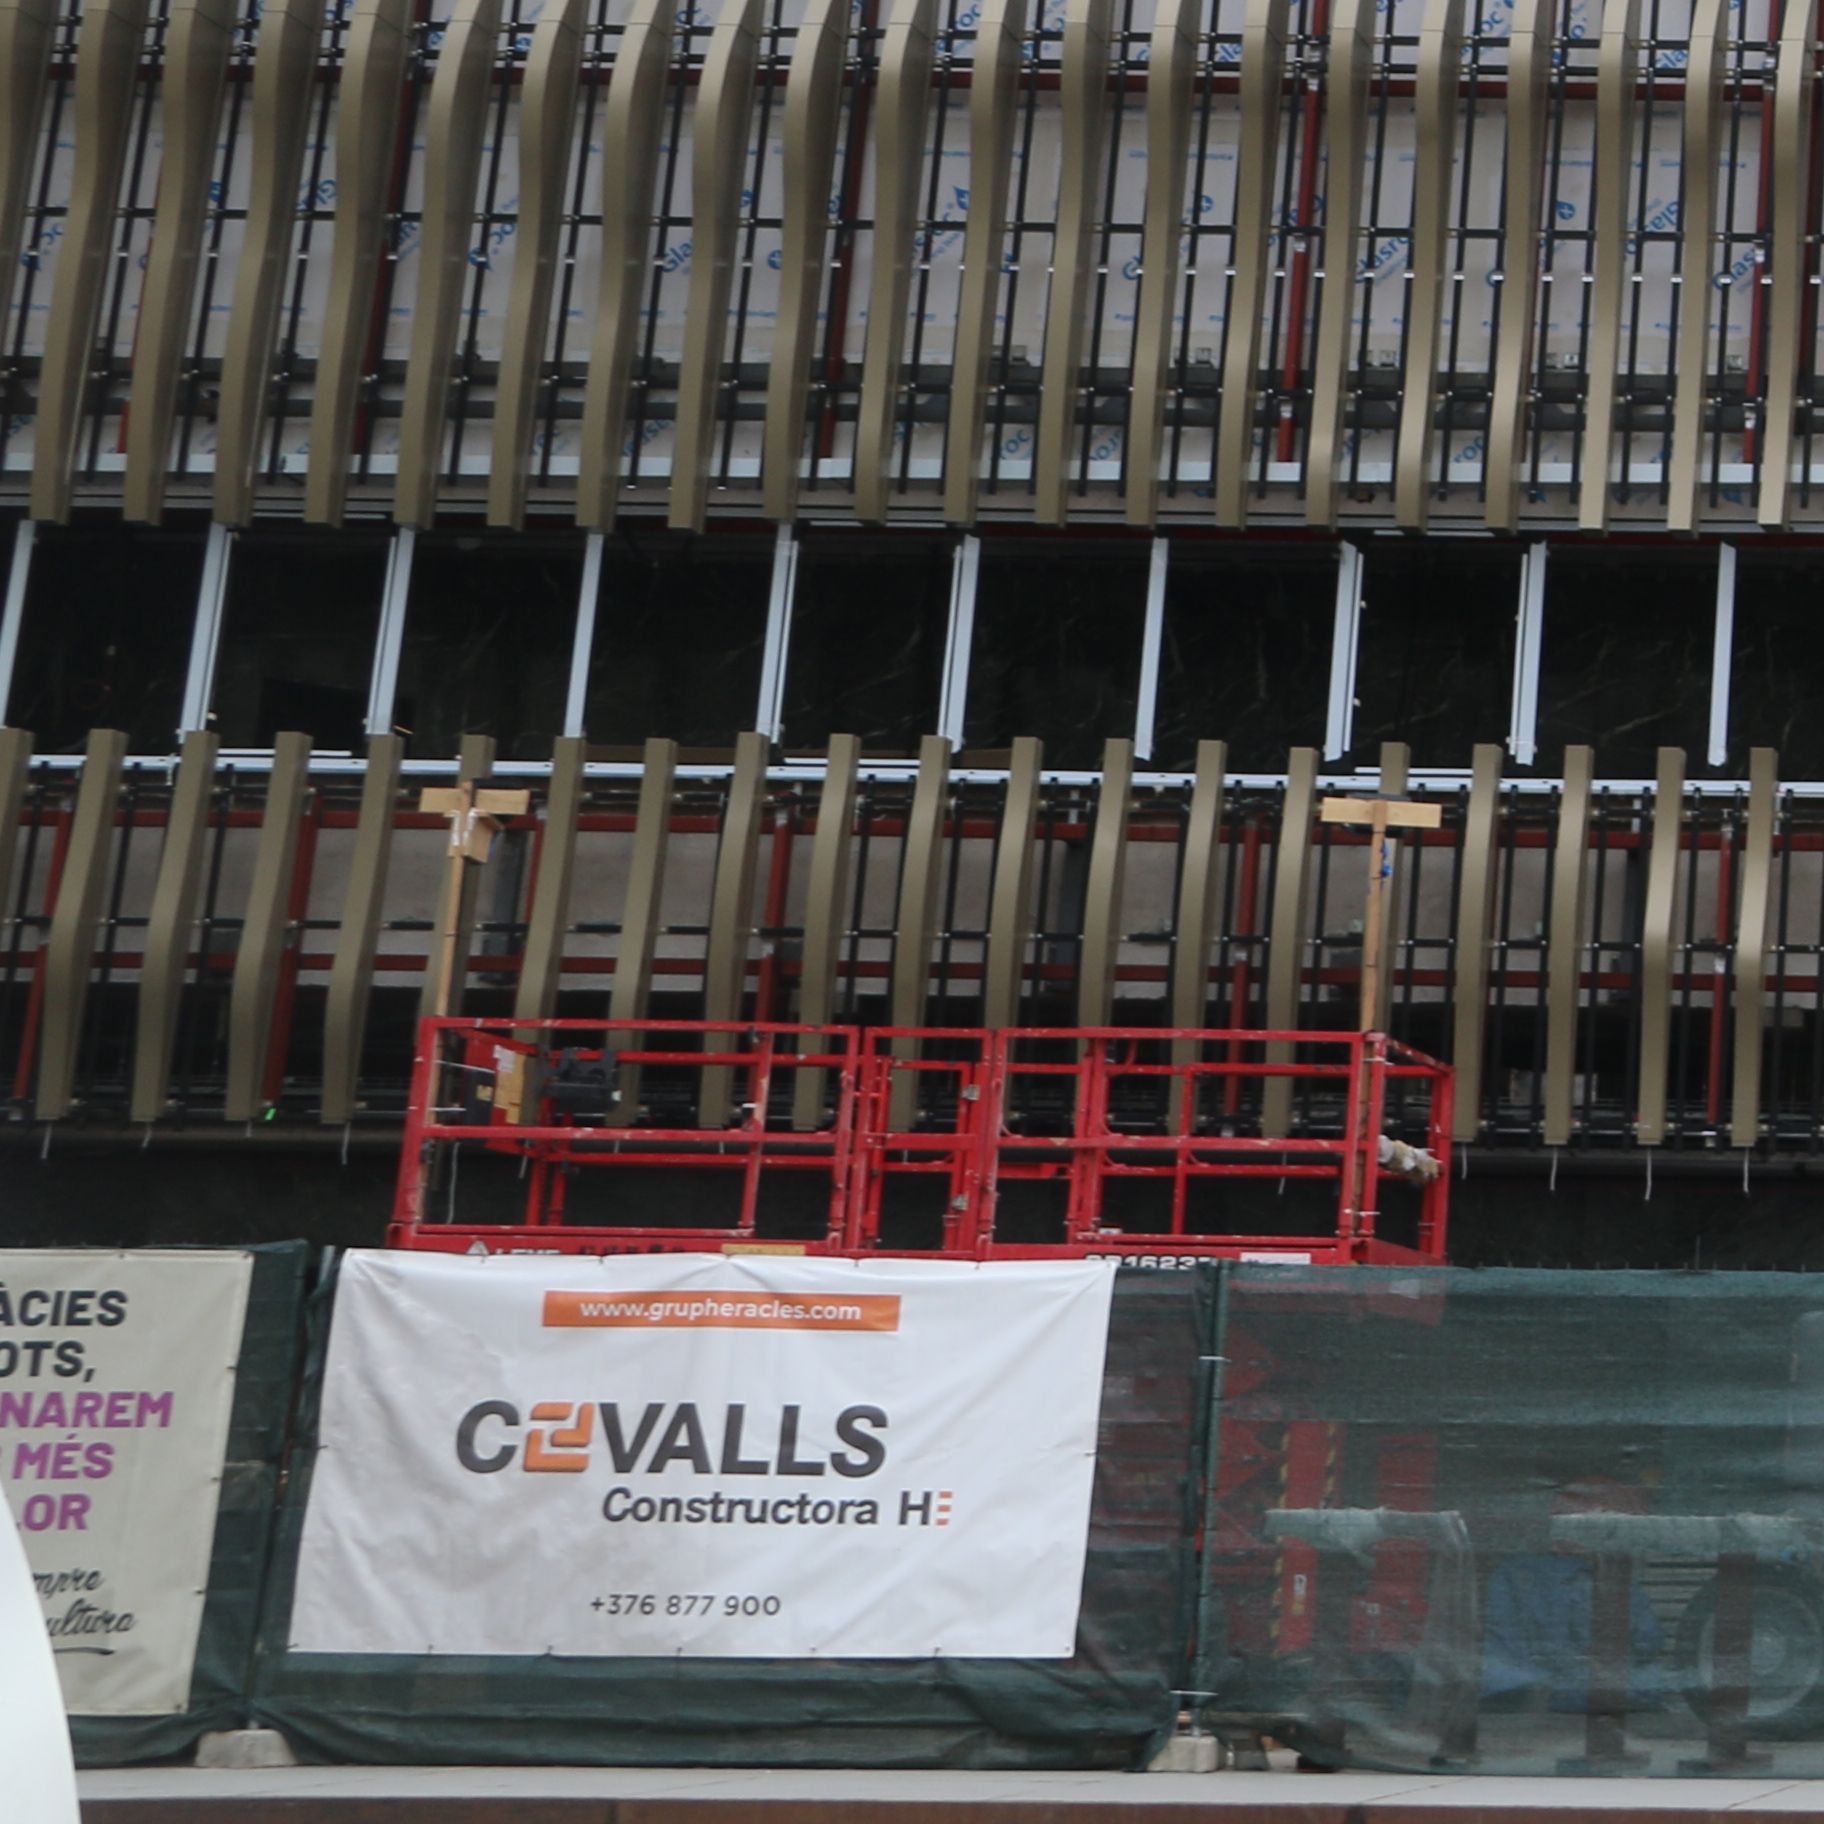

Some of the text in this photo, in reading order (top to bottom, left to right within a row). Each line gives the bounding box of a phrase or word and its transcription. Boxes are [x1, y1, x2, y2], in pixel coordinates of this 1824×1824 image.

[579, 1298, 863, 1323] www.grupheracles.com
[13, 1434, 115, 1479] MÉS
[602, 1487, 879, 1526] Constructora
[590, 1594, 781, 1617] +376 877 900
